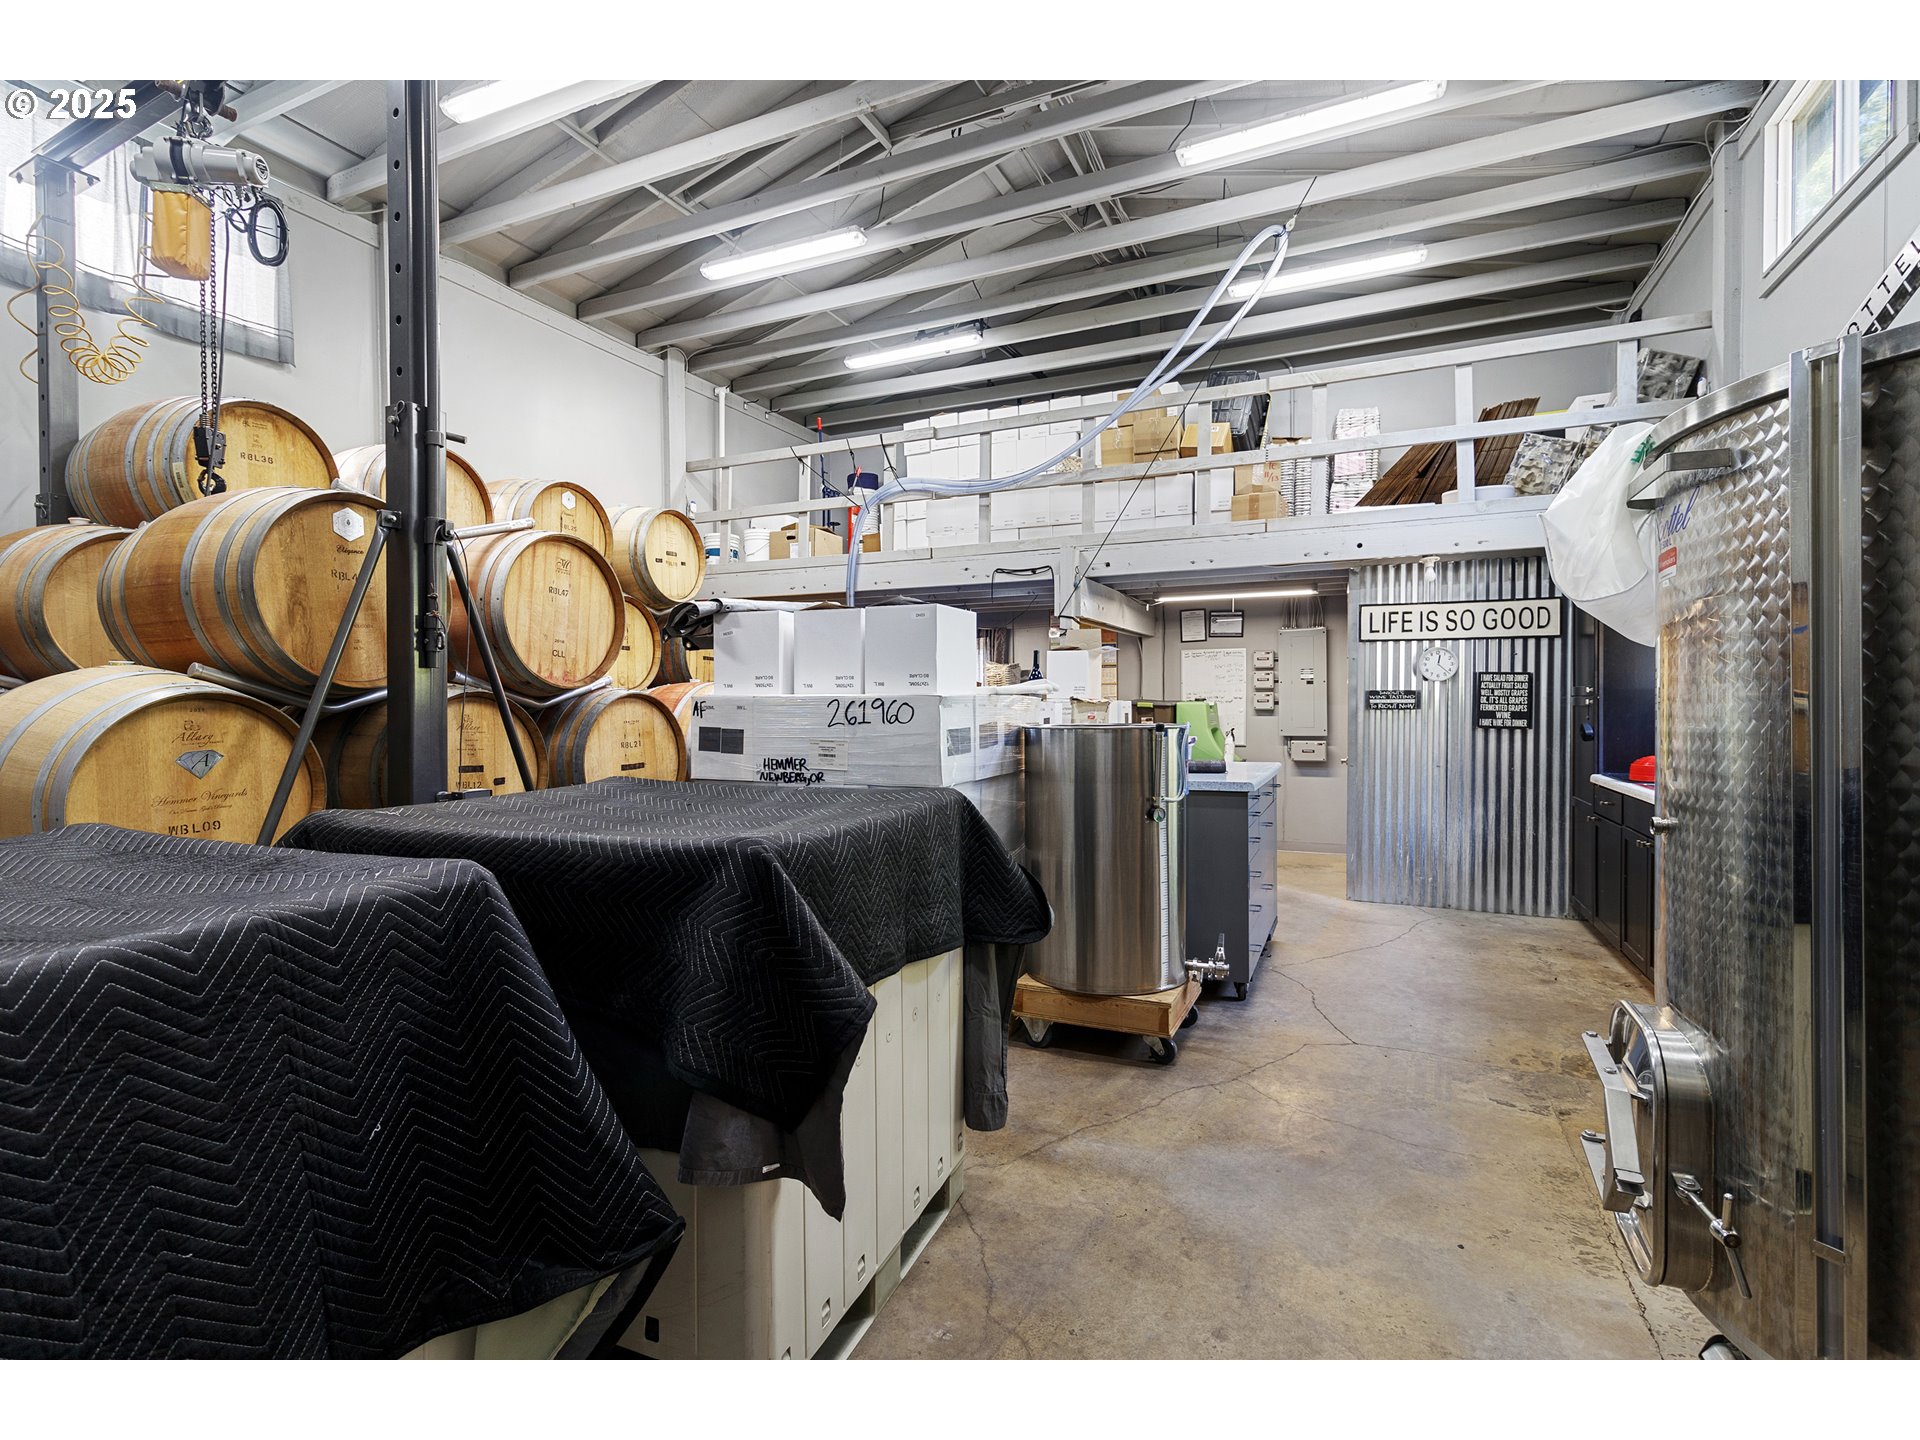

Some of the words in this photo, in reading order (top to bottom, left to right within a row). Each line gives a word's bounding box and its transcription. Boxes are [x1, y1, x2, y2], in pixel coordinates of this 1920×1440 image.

[1369, 611, 1413, 634] LIFE
[1419, 610, 1439, 632] IS
[1445, 609, 1475, 632] SO
[1483, 606, 1551, 630] GOOD
[552, 649, 566, 659] CLL
[1493, 674, 1506, 682] SALAD
[1506, 674, 1514, 682] FOR
[1514, 674, 1529, 682] DINNER
[1511, 689, 1529, 697] GRAPES
[1499, 696, 1508, 704] ALL
[1508, 696, 1528, 704] GRAPES
[1480, 703, 1508, 711] FERMENTED
[1508, 704, 1528, 712] GRAPES
[827, 697, 915, 728] 261960
[1495, 711, 1512, 719] WINE
[1503, 718, 1512, 727] FOR
[1511, 719, 1528, 727] DINNER
[191, 752, 210, 770] A
[763, 756, 810, 772] HEMMER
[150, 795, 198, 808] Hemmer
[200, 787, 248, 803] Vineyards
